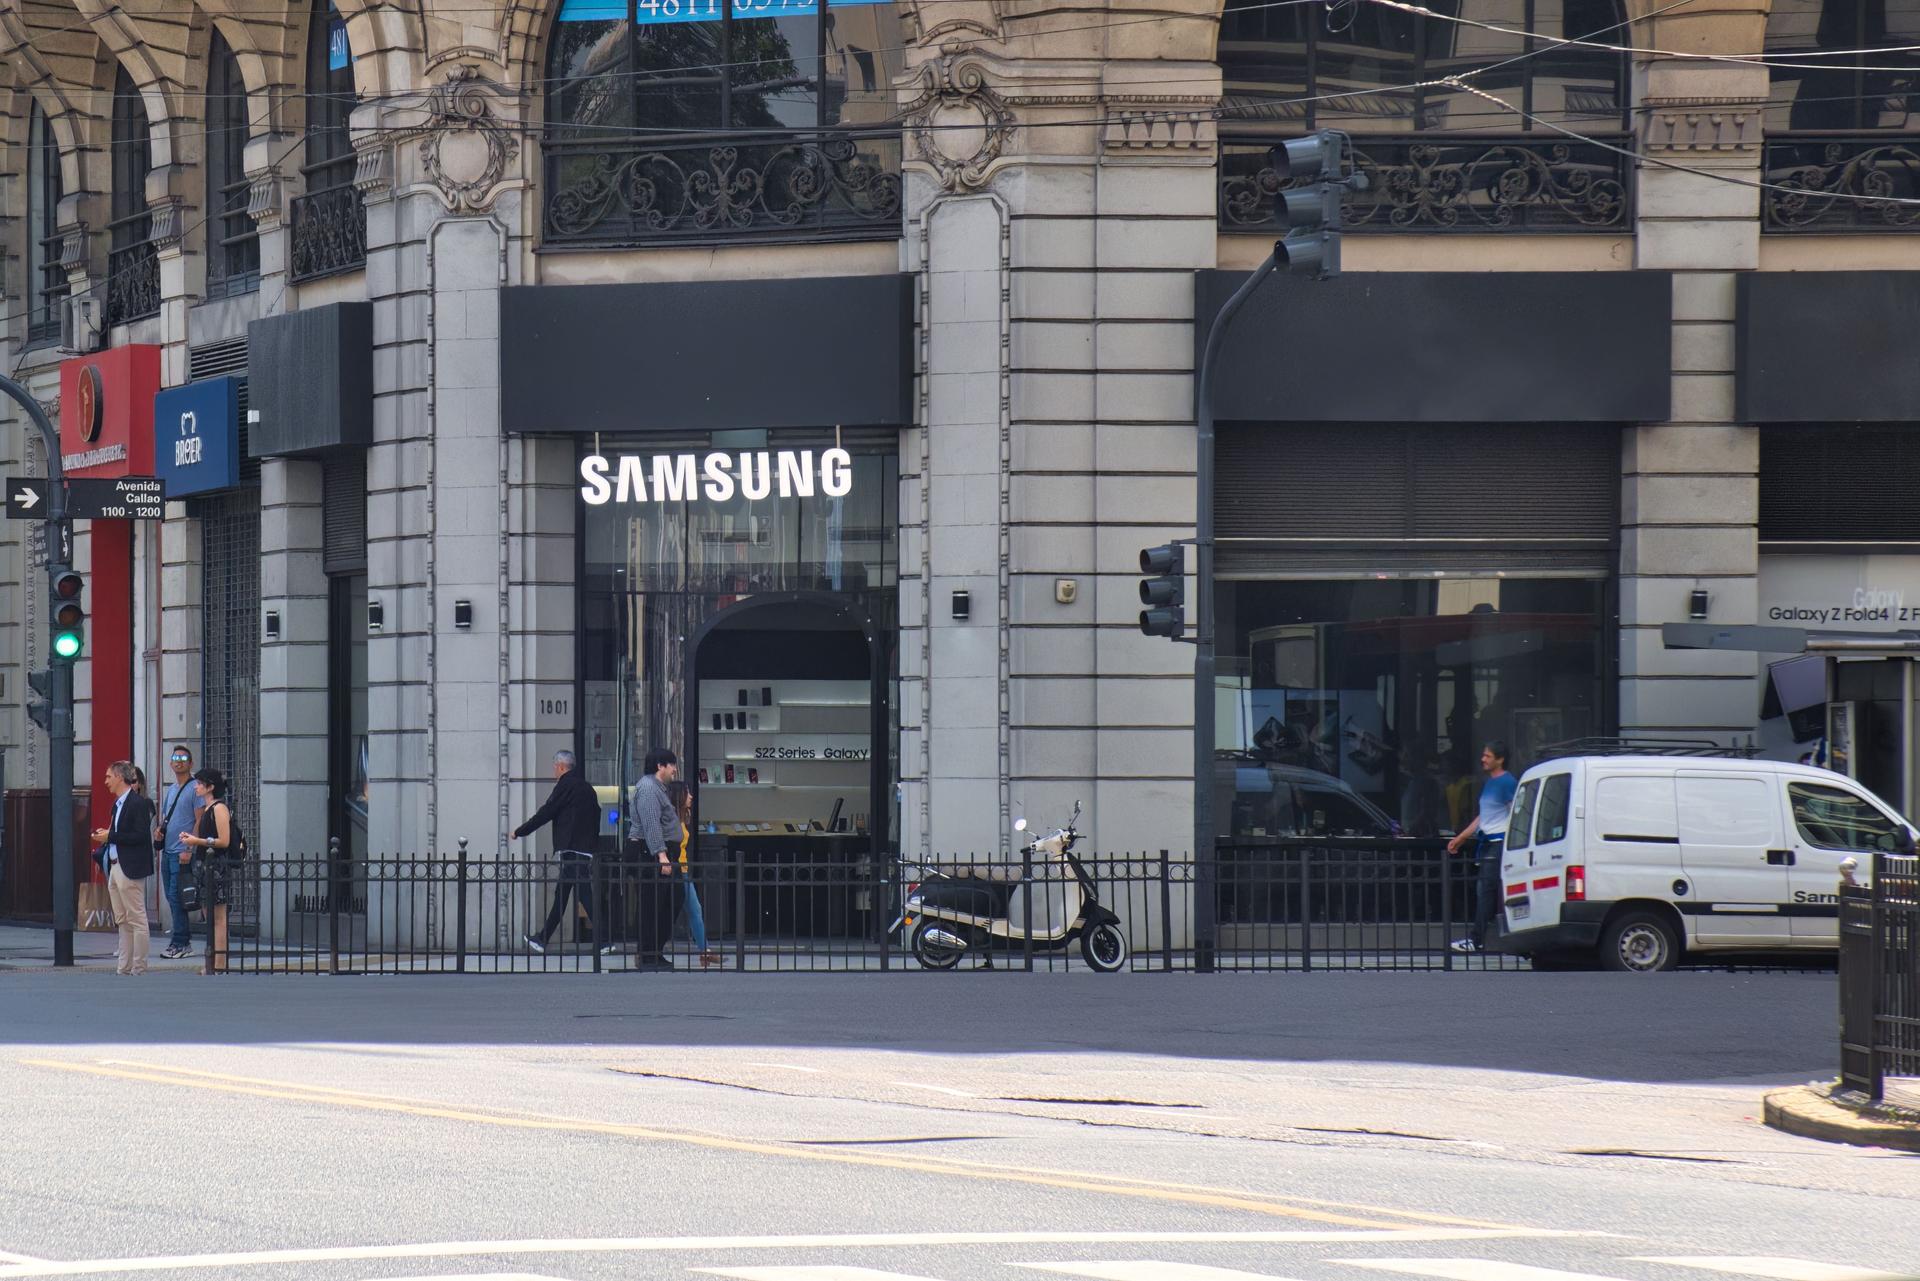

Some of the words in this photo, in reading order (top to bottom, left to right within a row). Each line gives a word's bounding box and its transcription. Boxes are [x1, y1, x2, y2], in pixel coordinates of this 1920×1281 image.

[580, 447, 852, 505] SAMSUNG
[115, 480, 160, 491] Avenida
[126, 493, 160, 503] Callao
[101, 507, 125, 517] 1100
[136, 507, 160, 517] 1200
[1769, 607, 1829, 624] Galaxy
[1831, 608, 1840, 620] Z
[1844, 607, 1889, 621] Fold4
[1898, 608, 1908, 621] Z
[540, 699, 567, 715] 1801
[755, 747, 776, 758] S22
[778, 746, 815, 758] Series
[823, 747, 868, 760] Galaxy
